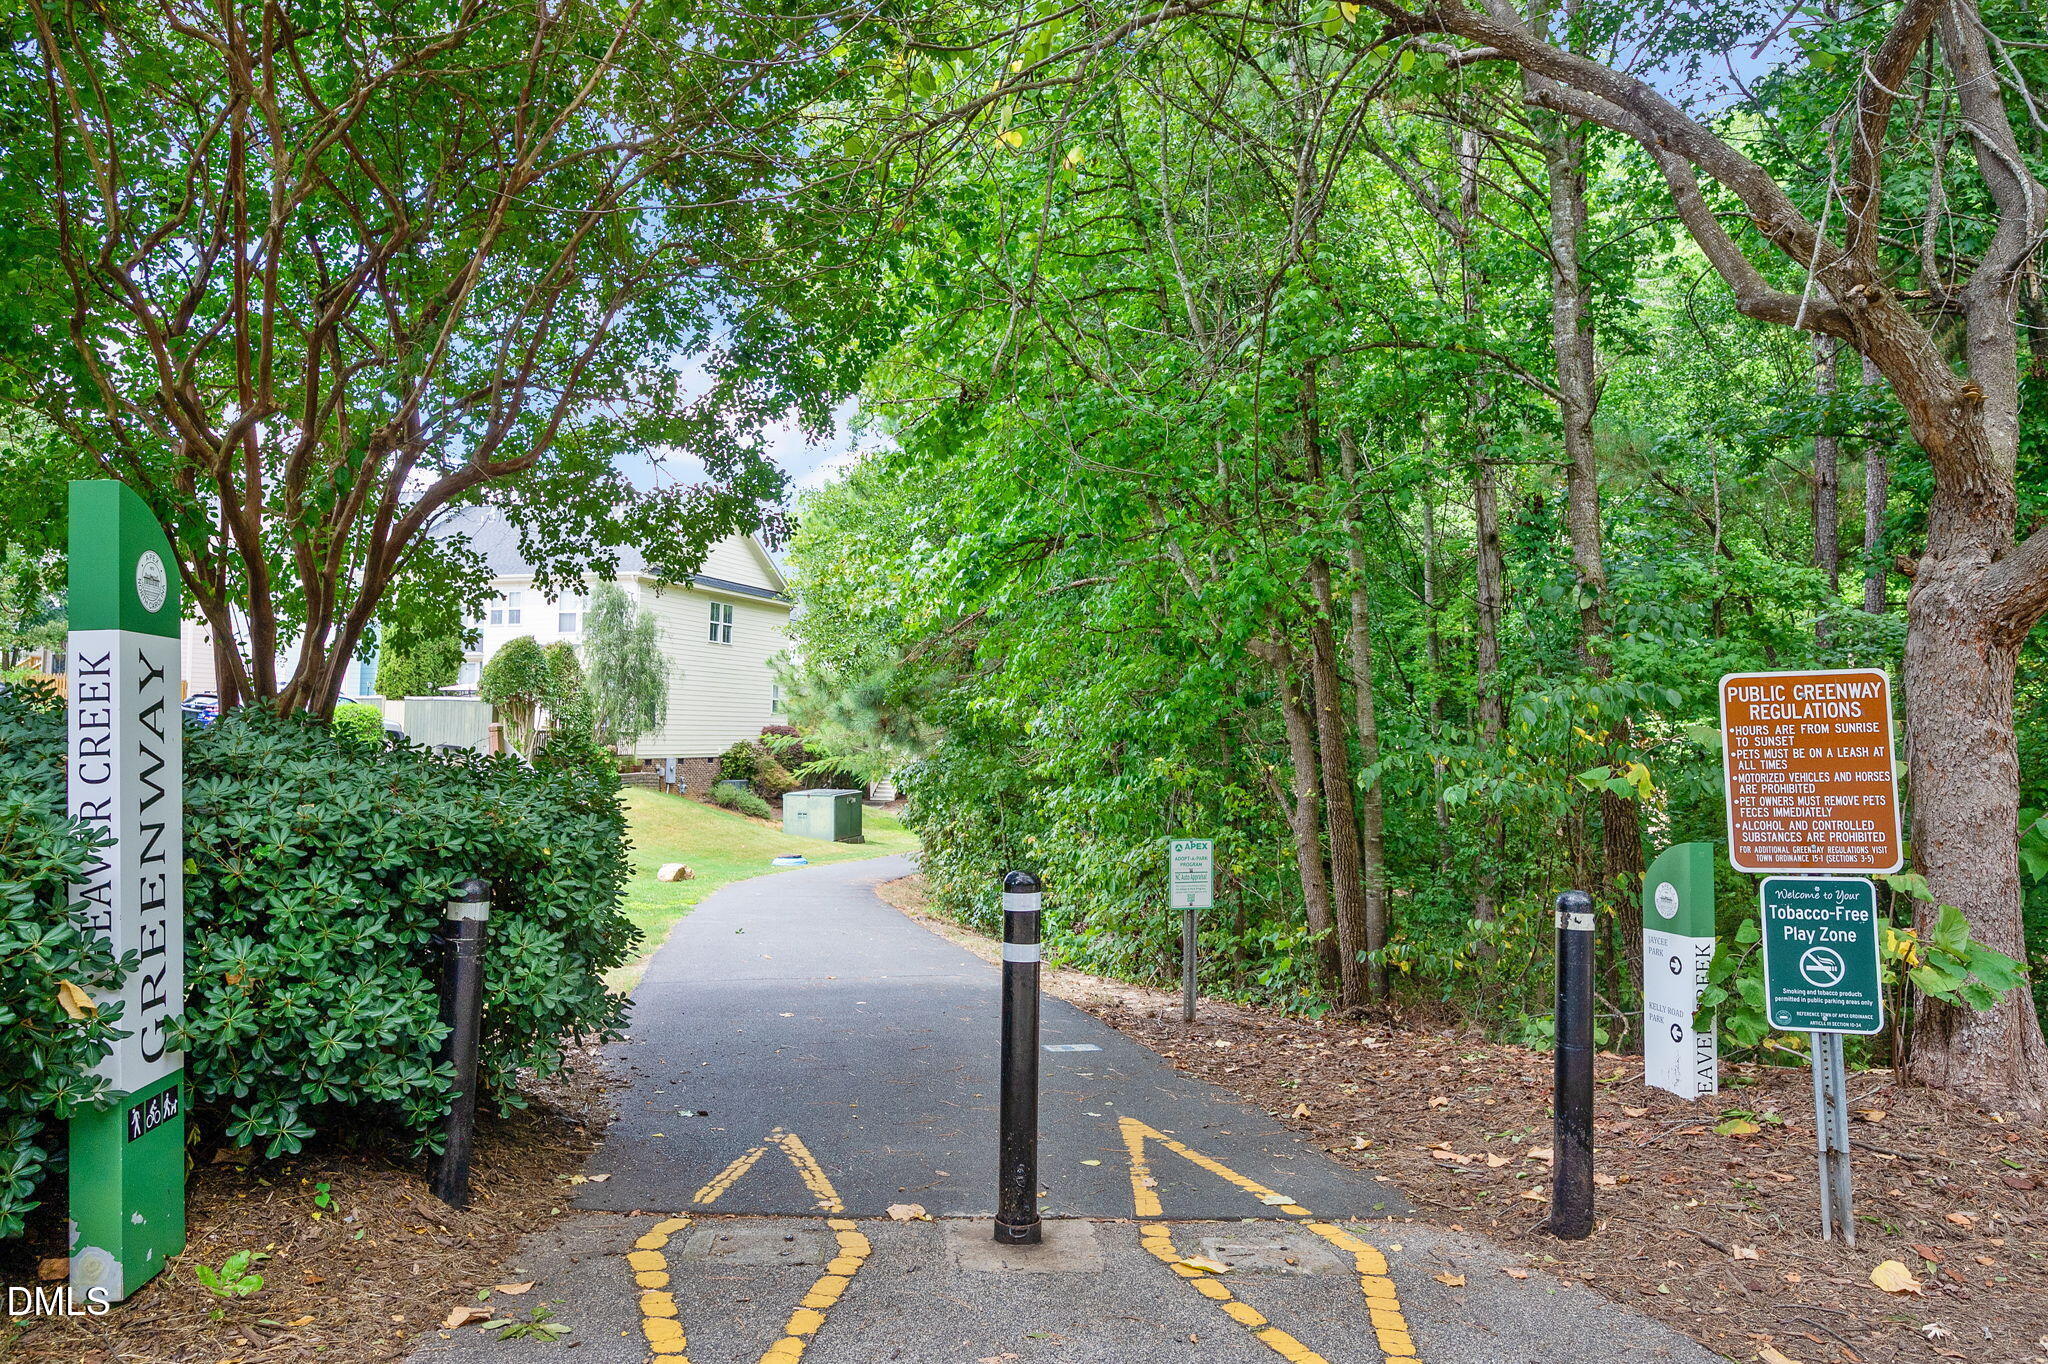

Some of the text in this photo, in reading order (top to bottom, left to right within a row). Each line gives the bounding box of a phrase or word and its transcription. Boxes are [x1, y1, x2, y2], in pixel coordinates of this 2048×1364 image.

[1727, 682, 1881, 702] PUBLIC GREENWAY
[1750, 702, 1862, 720] REGULATIONS
[1736, 722, 1879, 735] HOURS ARE FROM SUNRISE
[1736, 736, 1794, 746] TO SUNSET
[1737, 747, 1885, 759] PETS MUST BE ON A LEASH AT
[1738, 760, 1787, 770] ALL TIMES
[1738, 771, 1890, 783] MOTORIZED VEHICLES AND HORSES
[1739, 784, 1815, 794] ARE PROHIBITED
[79, 650, 112, 956] EAVR CREEK
[1740, 796, 1886, 806] PET OWNERS MUST REMOVE PETS
[1740, 807, 1833, 817] FECES IMMEDIATELY
[1742, 820, 1874, 831] ALCOHOL AND CONTROLLED
[1742, 832, 1885, 842] SUBSTANCES ARE PROHIBITED
[139, 648, 167, 1063] GREENWAY
[1740, 846, 1751, 854] FOR
[1754, 846, 1789, 854] ADDITIONAL
[1826, 854, 1858, 863] (SECTIONS
[1861, 854, 1874, 863] 3-5)
[1775, 888, 1820, 899] Welcome
[1835, 890, 1860, 904] Your
[1769, 905, 1869, 922] Tobacco-Free
[1784, 926, 1857, 944] Play Zone
[1648, 936, 1668, 946] JAYCEE
[1649, 947, 1664, 957] PARK
[1695, 944, 1711, 1010] EEK
[1783, 988, 1805, 996] Smoking
[1649, 1002, 1683, 1017] KELLY ROAD
[1649, 1013, 1664, 1023] PARK
